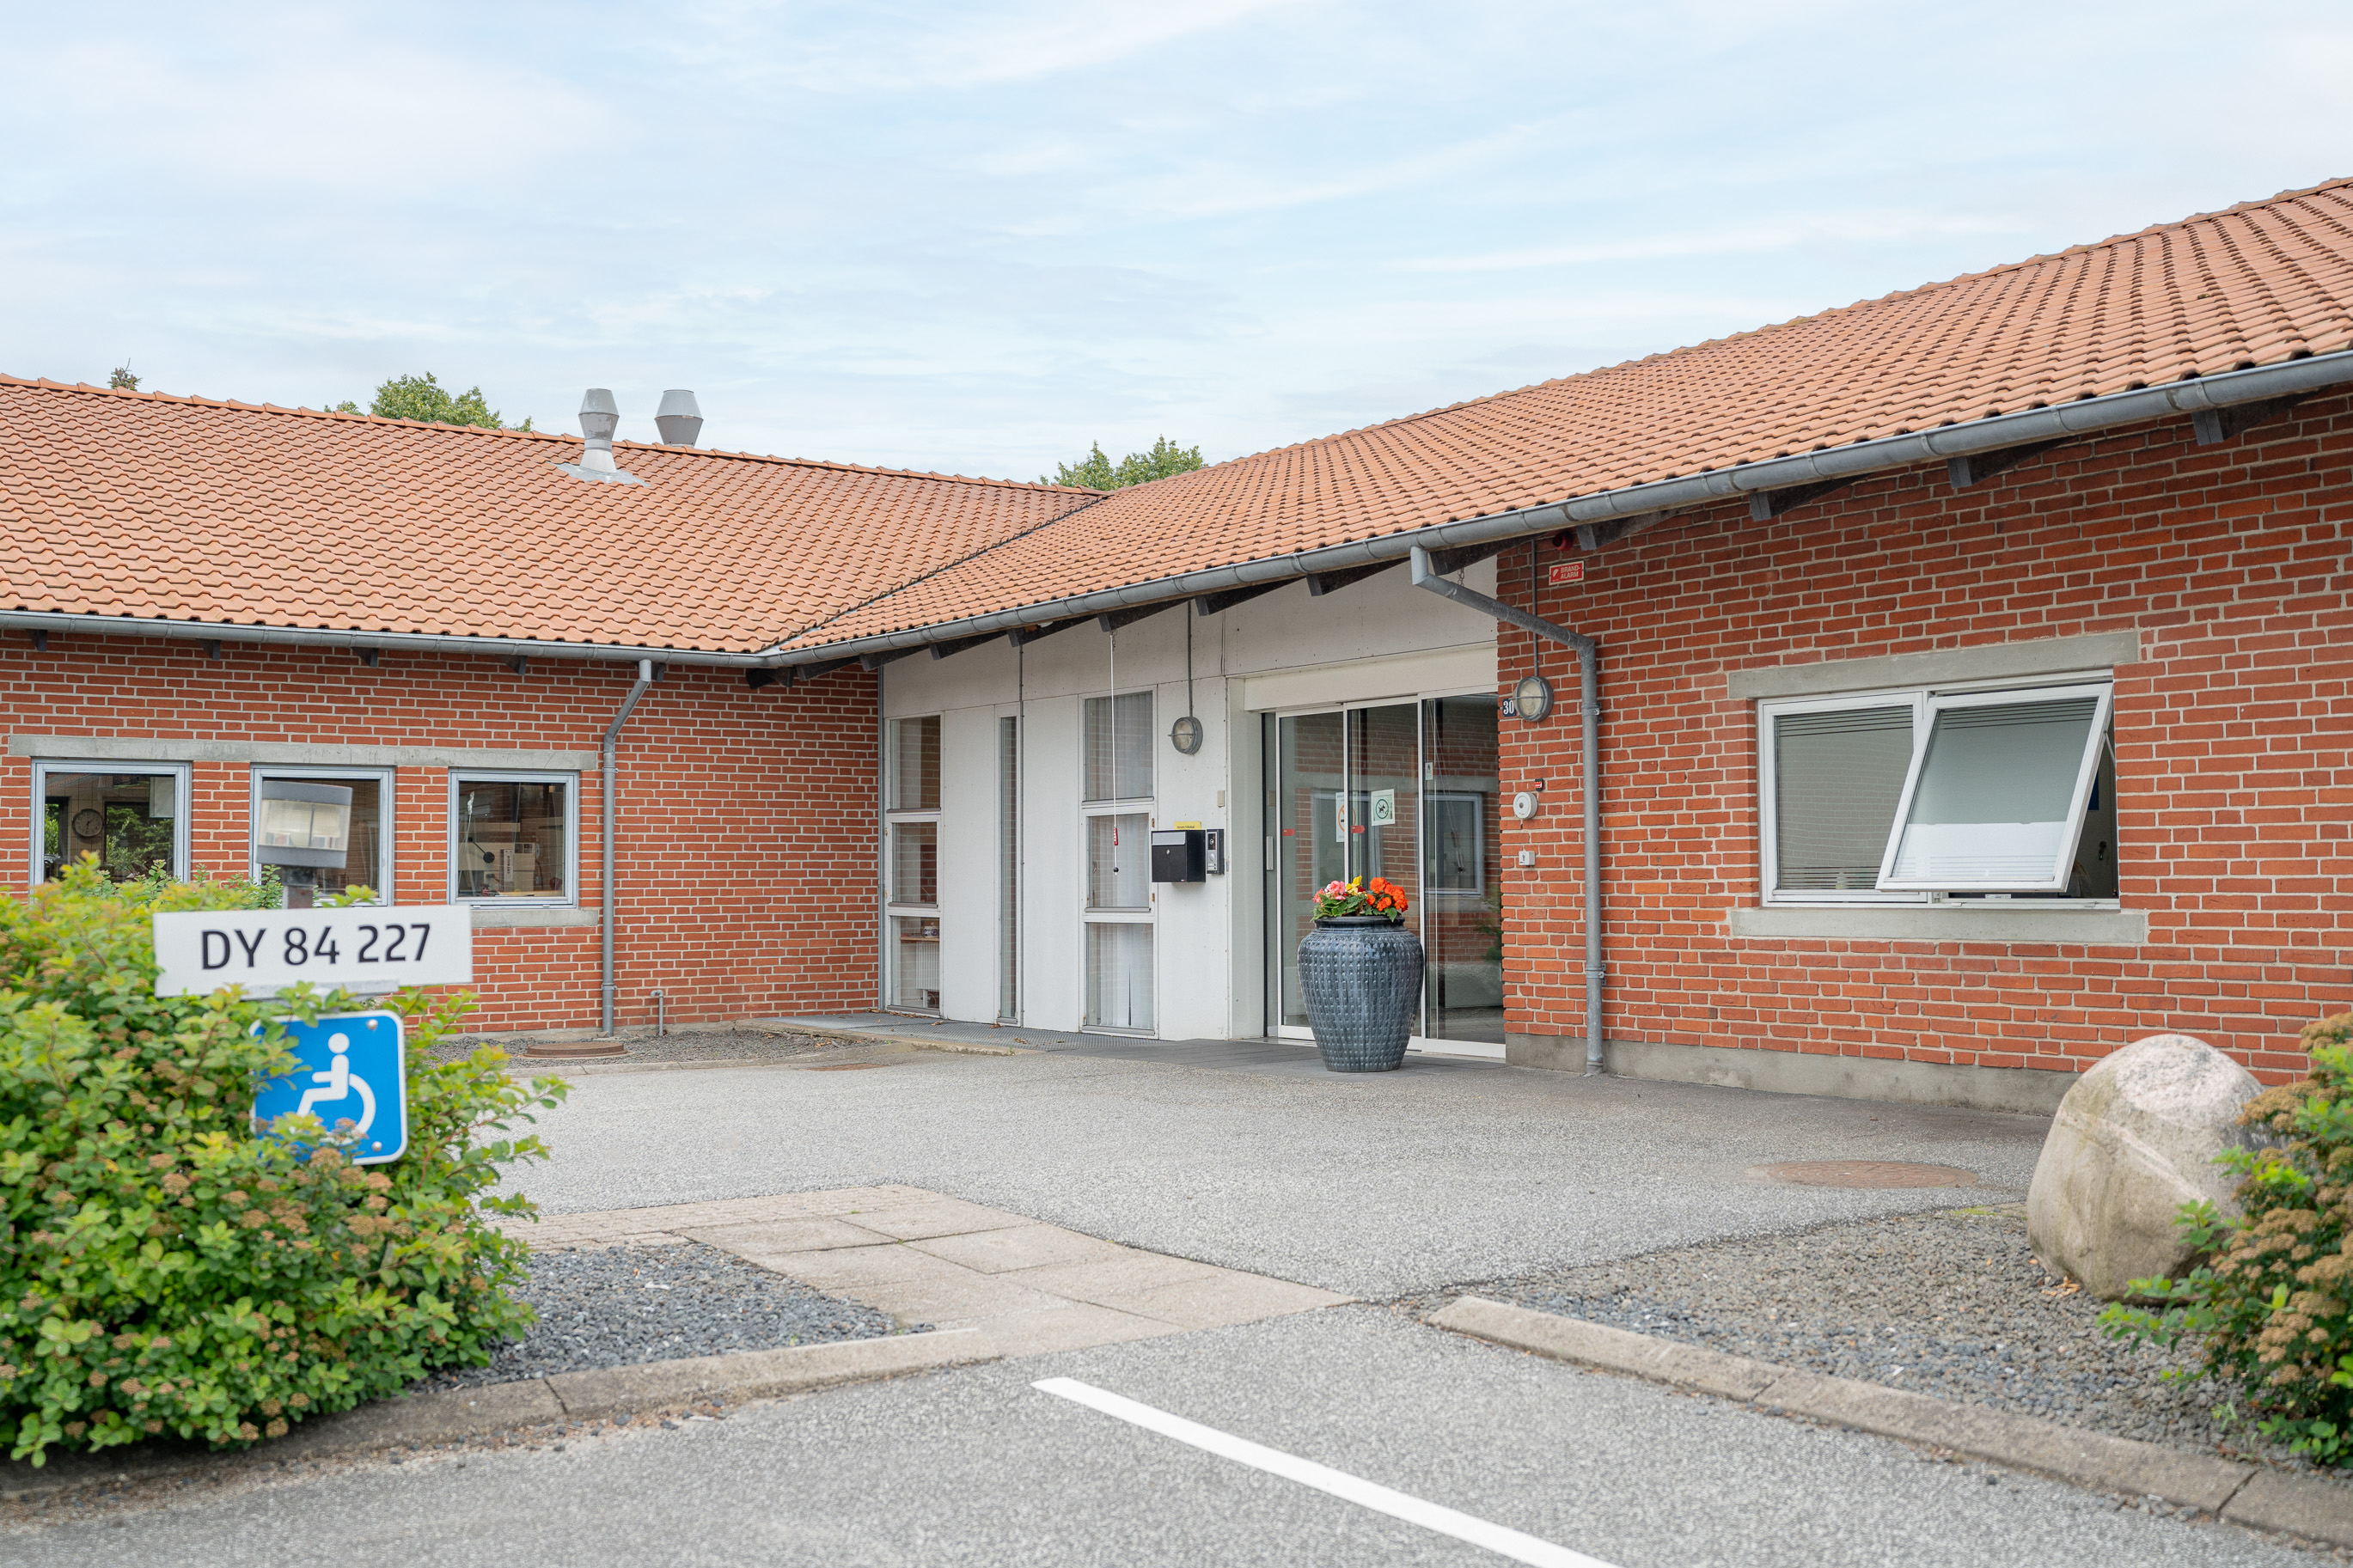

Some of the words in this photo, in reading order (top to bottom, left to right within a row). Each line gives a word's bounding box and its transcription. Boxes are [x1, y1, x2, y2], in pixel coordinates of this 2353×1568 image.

[1561, 564, 1580, 573] BRAND-
[1503, 699, 1514, 715] 30
[201, 928, 266, 970] DY
[284, 926, 340, 966] 84
[358, 924, 431, 963] 227
